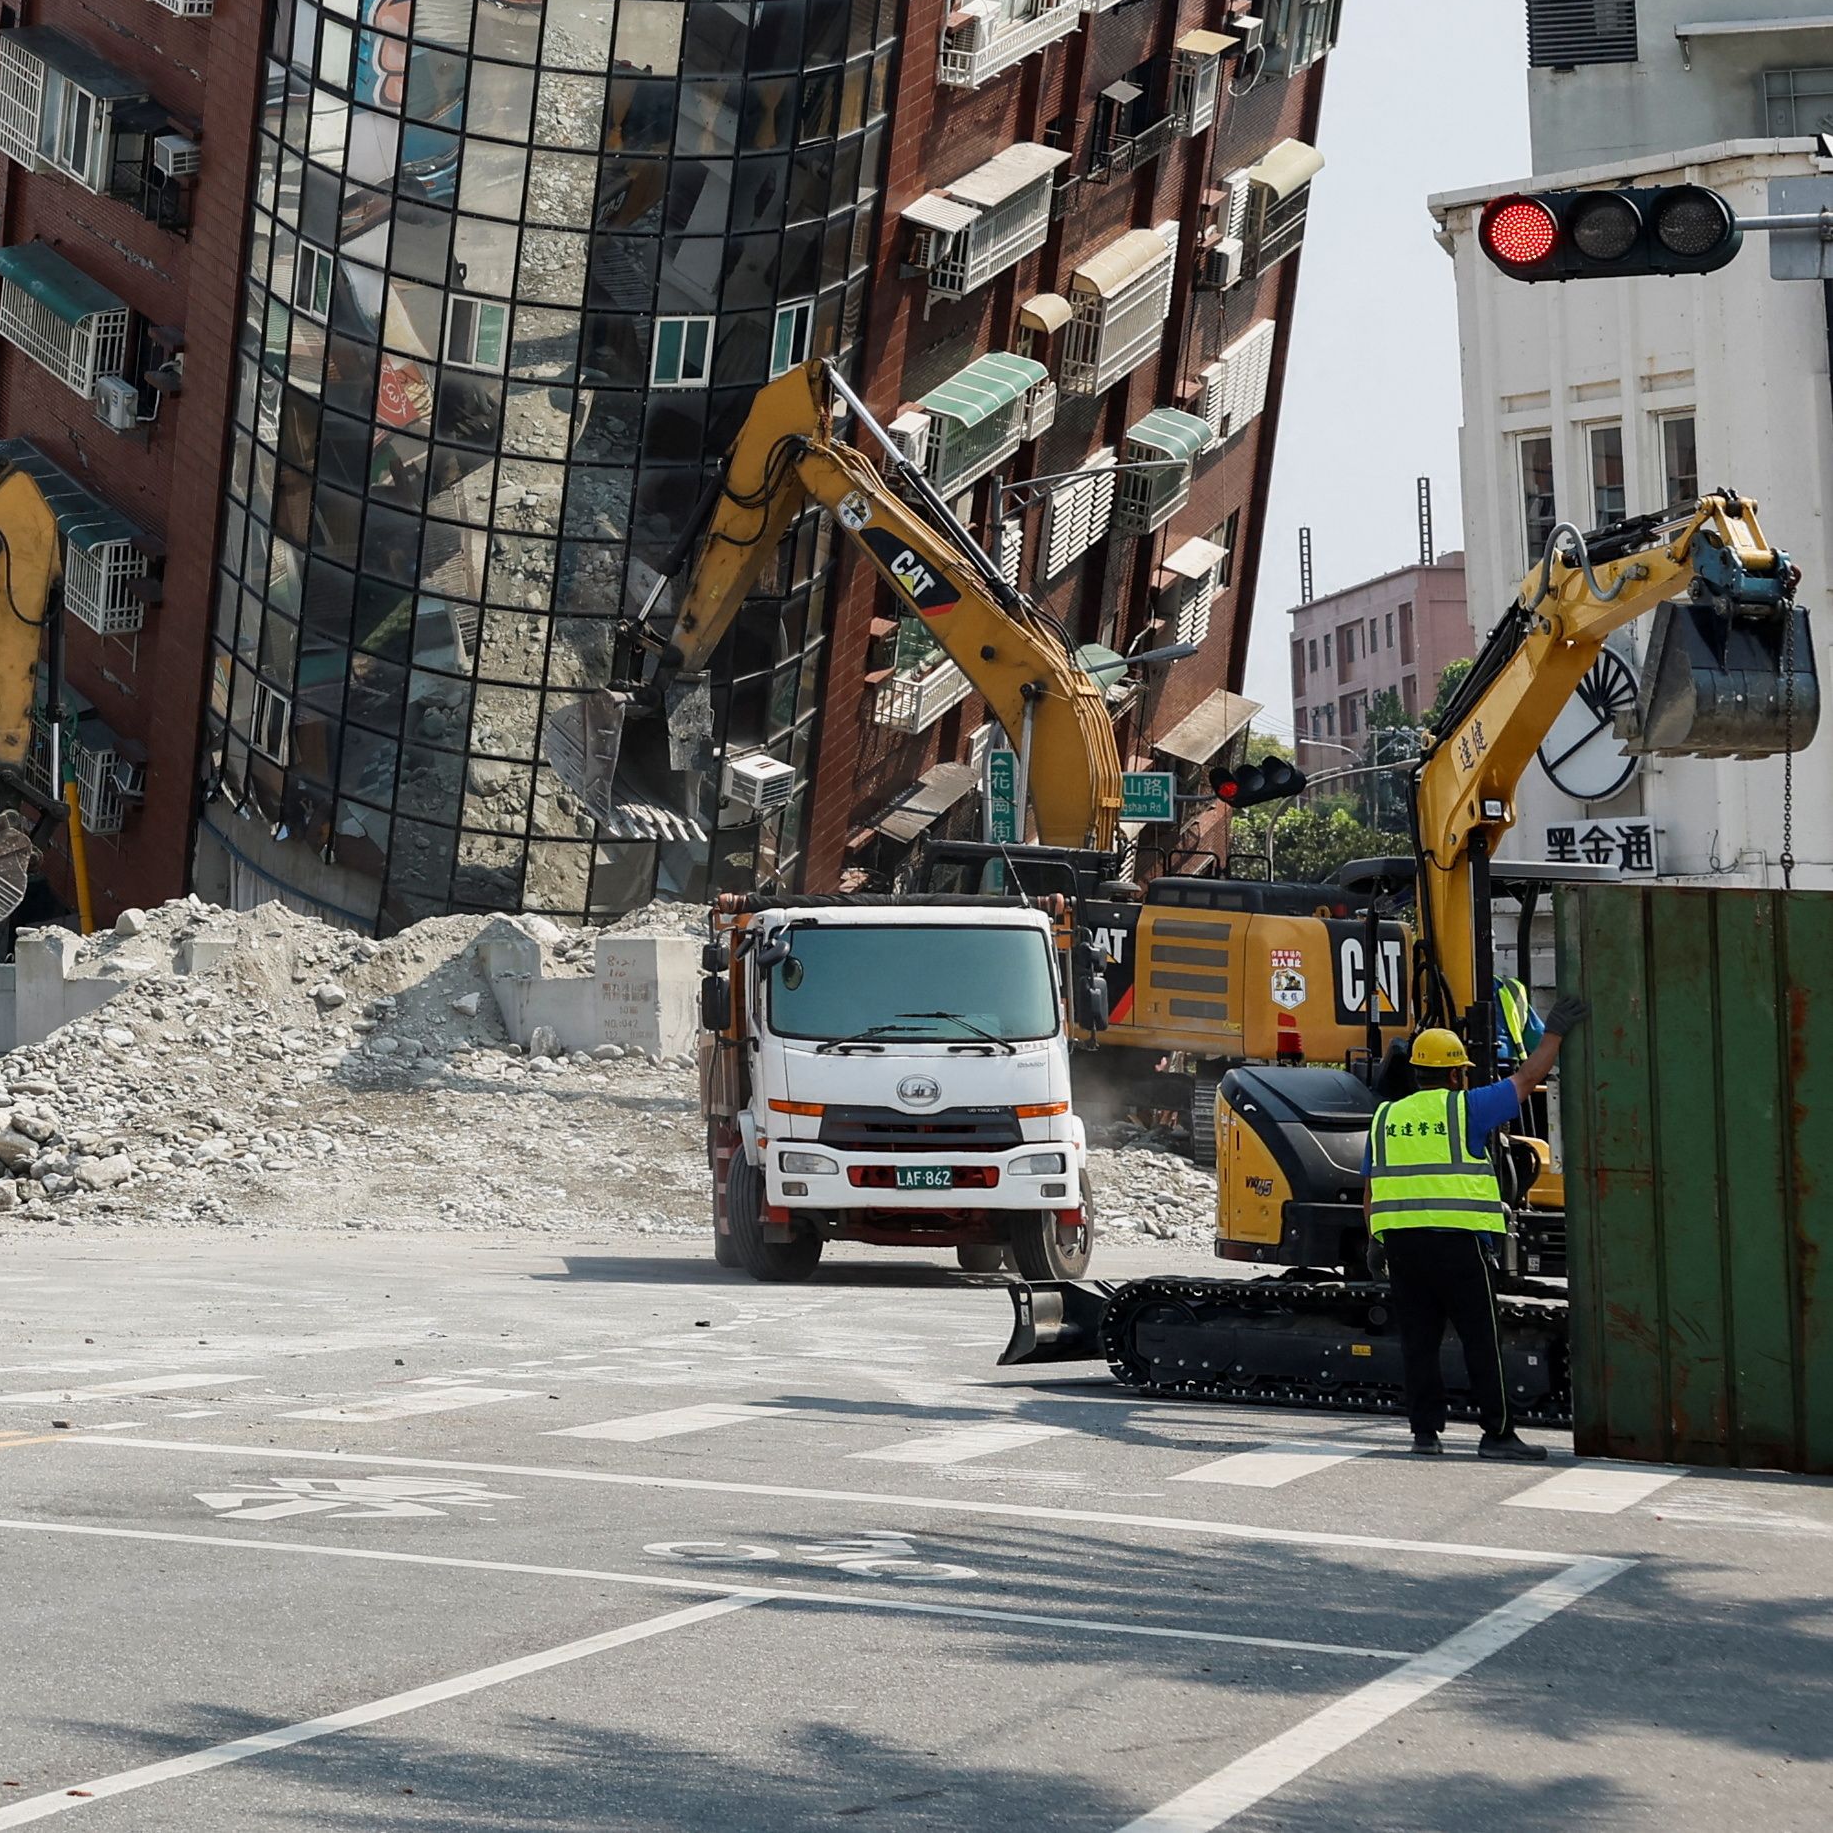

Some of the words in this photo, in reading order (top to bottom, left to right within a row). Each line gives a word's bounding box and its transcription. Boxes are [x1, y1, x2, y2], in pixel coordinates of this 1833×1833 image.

[890, 549, 936, 599] CAT
[991, 770, 1011, 840] 花崗街
[1122, 777, 1163, 798] 山路
[1121, 802, 1148, 816] gshan
[1544, 824, 1654, 873] 黑金通
[1092, 928, 1128, 964] AT
[1341, 937, 1401, 1013] CAT
[1384, 1120, 1448, 1139] 健達營造
